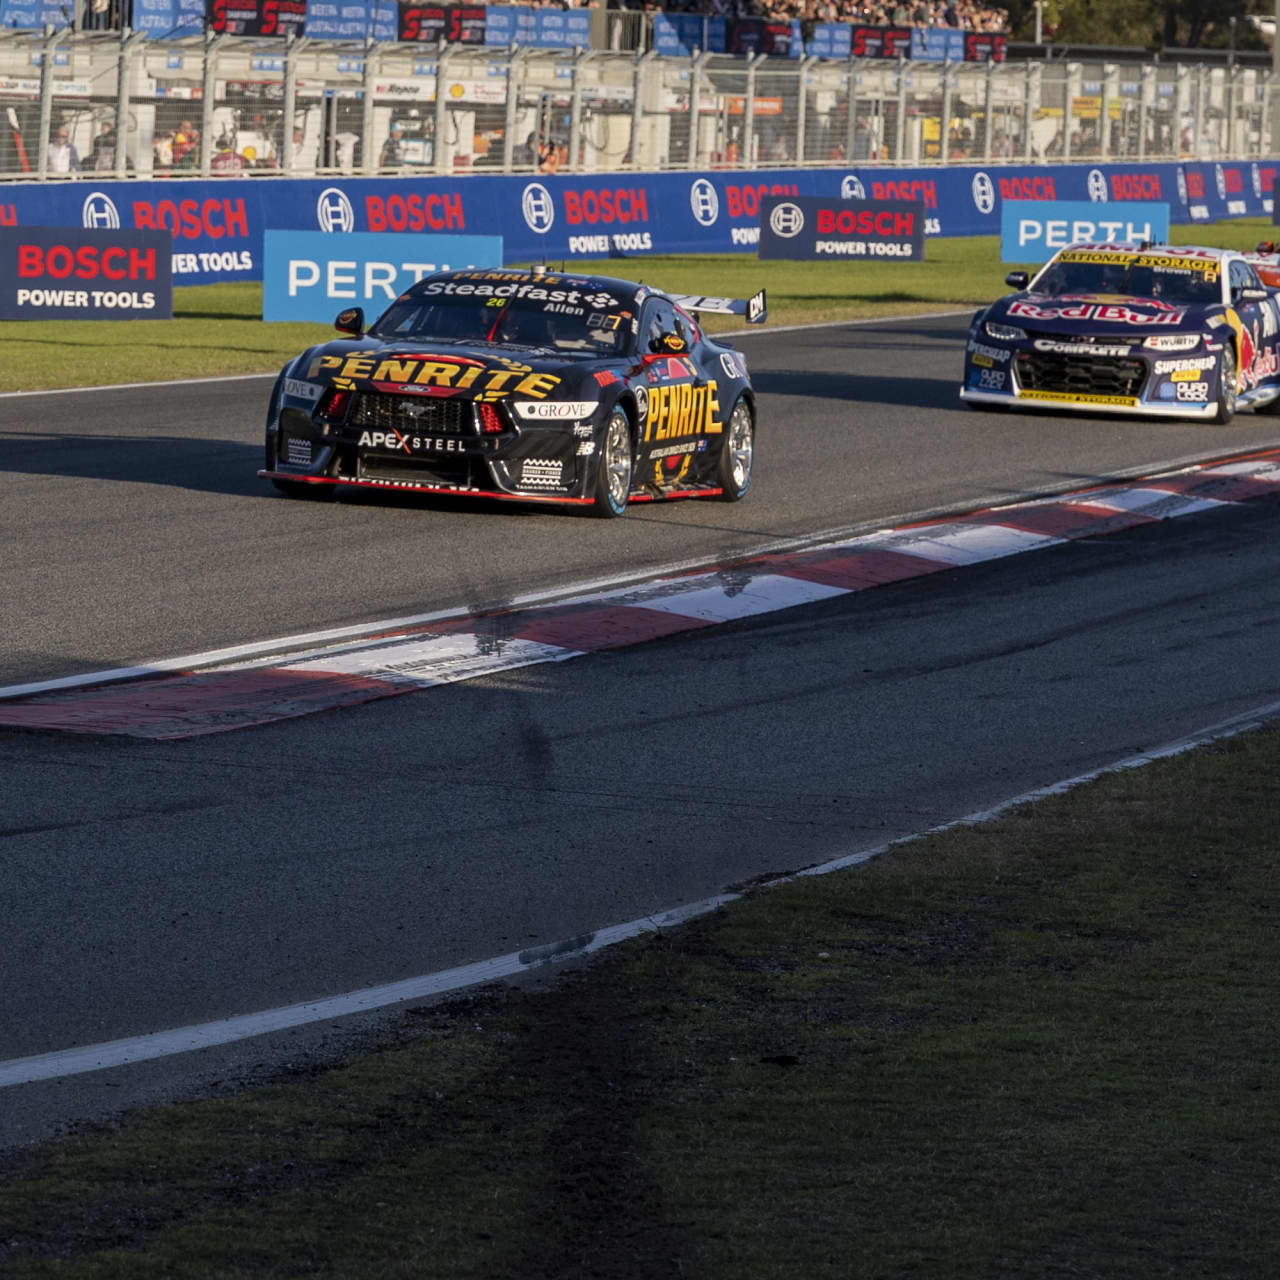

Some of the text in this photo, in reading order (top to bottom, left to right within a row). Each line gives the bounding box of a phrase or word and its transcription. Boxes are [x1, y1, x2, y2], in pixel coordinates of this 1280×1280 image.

[999, 177, 1056, 201] BOSCH
[1112, 174, 1161, 201] BOSCH
[133, 198, 249, 239] BOSCH
[365, 193, 465, 233] BOSCH
[564, 189, 648, 225] BOSCH
[817, 209, 914, 236] BOSCH
[1019, 219, 1151, 247] PERTH
[613, 232, 652, 250] TOOLS
[816, 241, 912, 257] POWER TOOLS
[19, 245, 156, 281] BOSCH
[199, 251, 253, 274] TOOLS
[1058, 251, 1215, 271] NATIONAL STORAGE
[289, 259, 475, 299] PERT
[453, 273, 562, 285] PENRITE
[17, 289, 156, 309] POWER TOOLS
[424, 282, 583, 305] Steadfast
[486, 298, 506, 308] 26
[543, 302, 585, 316] Allen
[1006, 301, 1187, 325] Red Bull
[1155, 356, 1216, 374] SUPERCHEAP
[306, 355, 562, 400] PENRITE
[538, 402, 587, 417] GROVE
[644, 380, 723, 443] PENRITE
[358, 428, 466, 455] APEX STEEL
